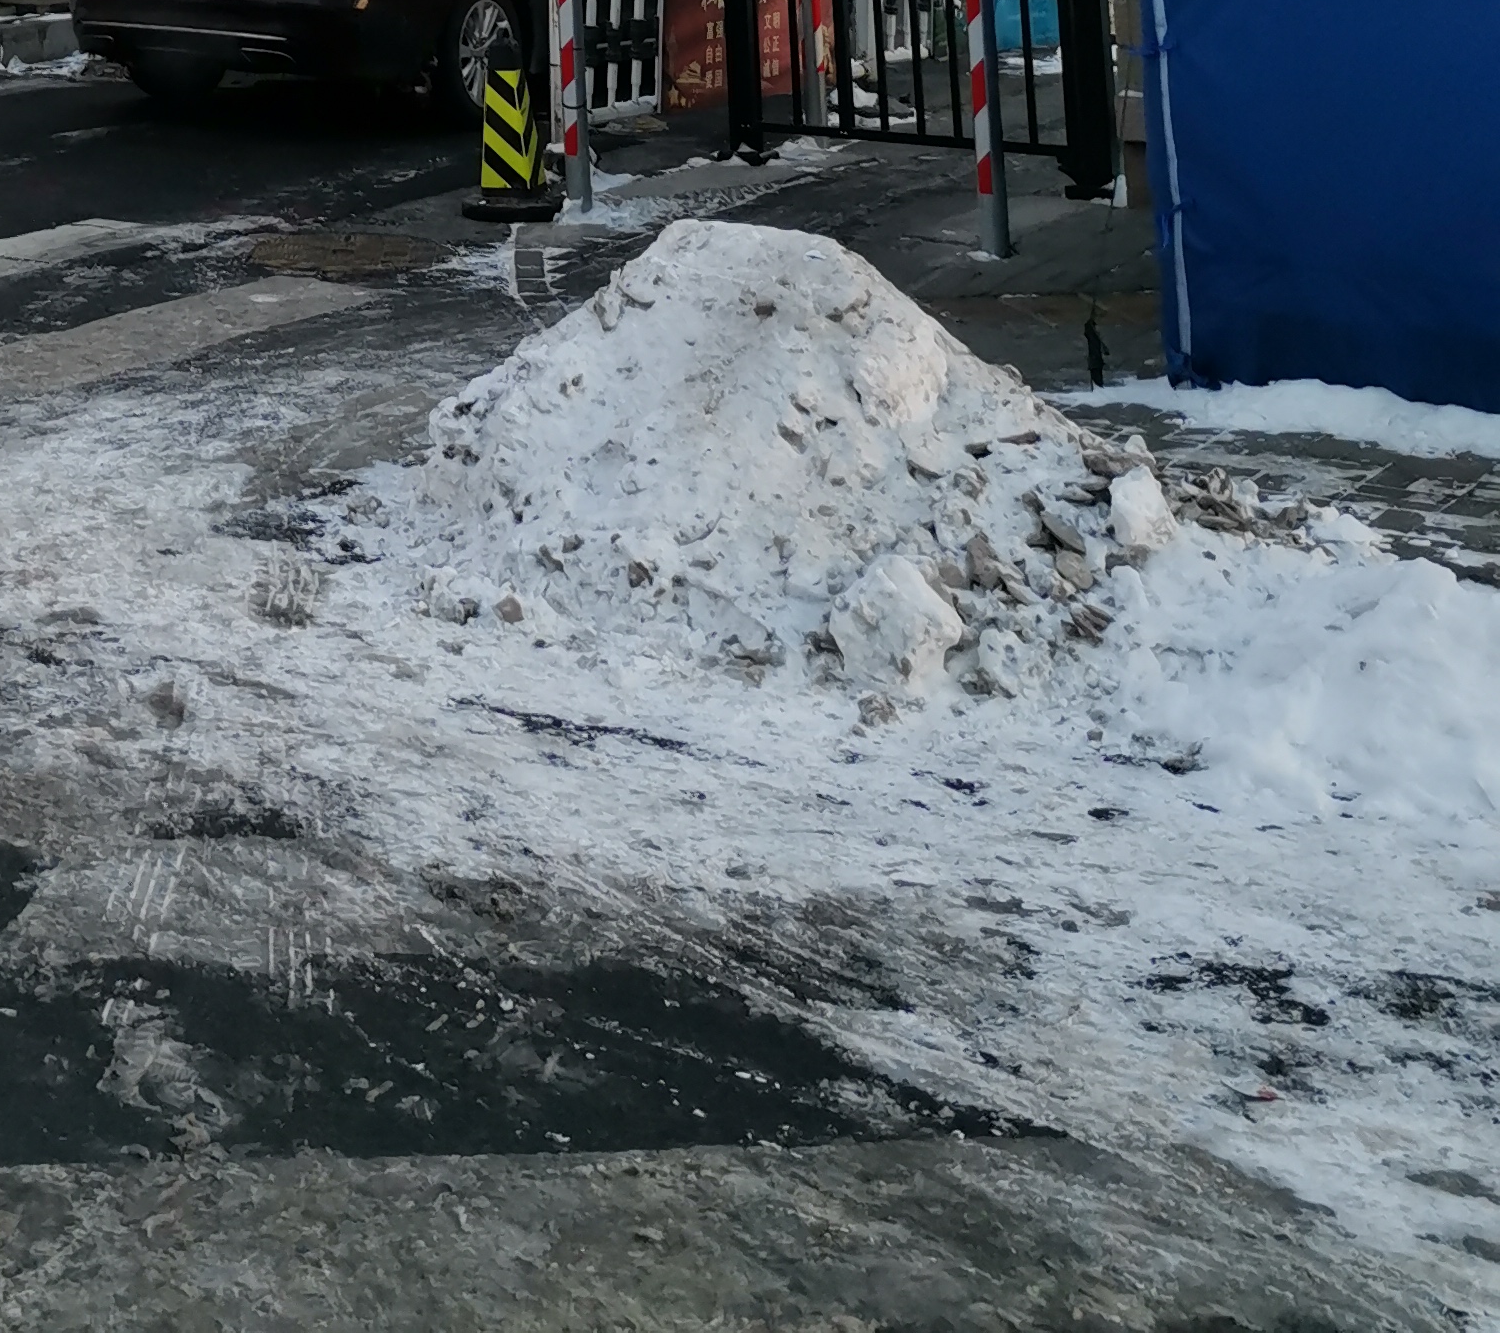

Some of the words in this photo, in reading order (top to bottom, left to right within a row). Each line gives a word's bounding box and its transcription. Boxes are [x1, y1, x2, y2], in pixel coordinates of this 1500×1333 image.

[763, 12, 781, 30] 文明
[763, 35, 781, 53] 公正
[705, 44, 723, 65] 自由
